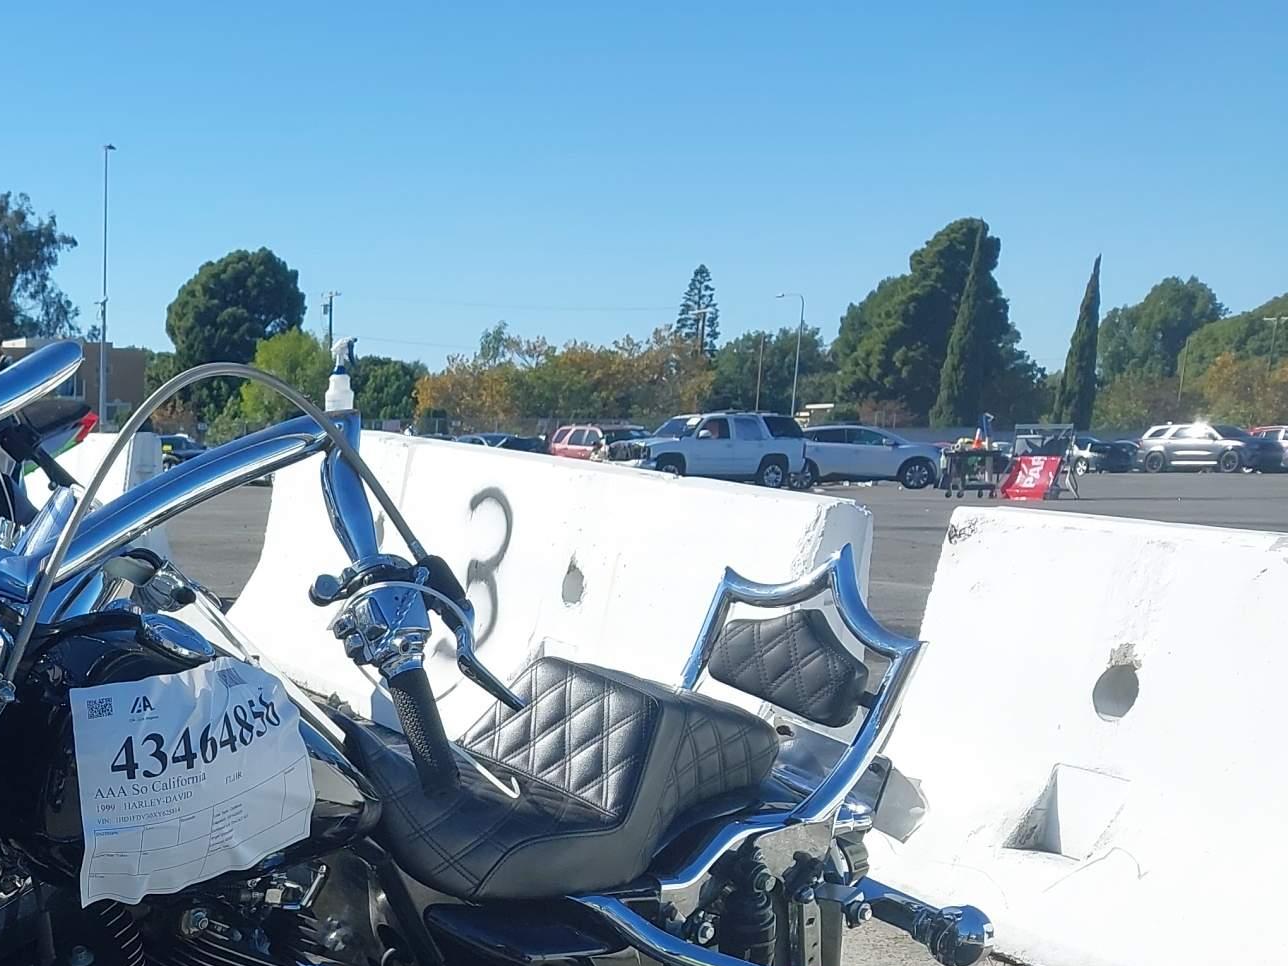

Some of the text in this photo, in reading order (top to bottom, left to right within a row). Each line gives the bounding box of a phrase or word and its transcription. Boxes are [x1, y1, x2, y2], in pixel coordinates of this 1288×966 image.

[94, 771, 207, 799] AAA So California
[96, 790, 193, 814] 1999 HARLEY-DAVID
